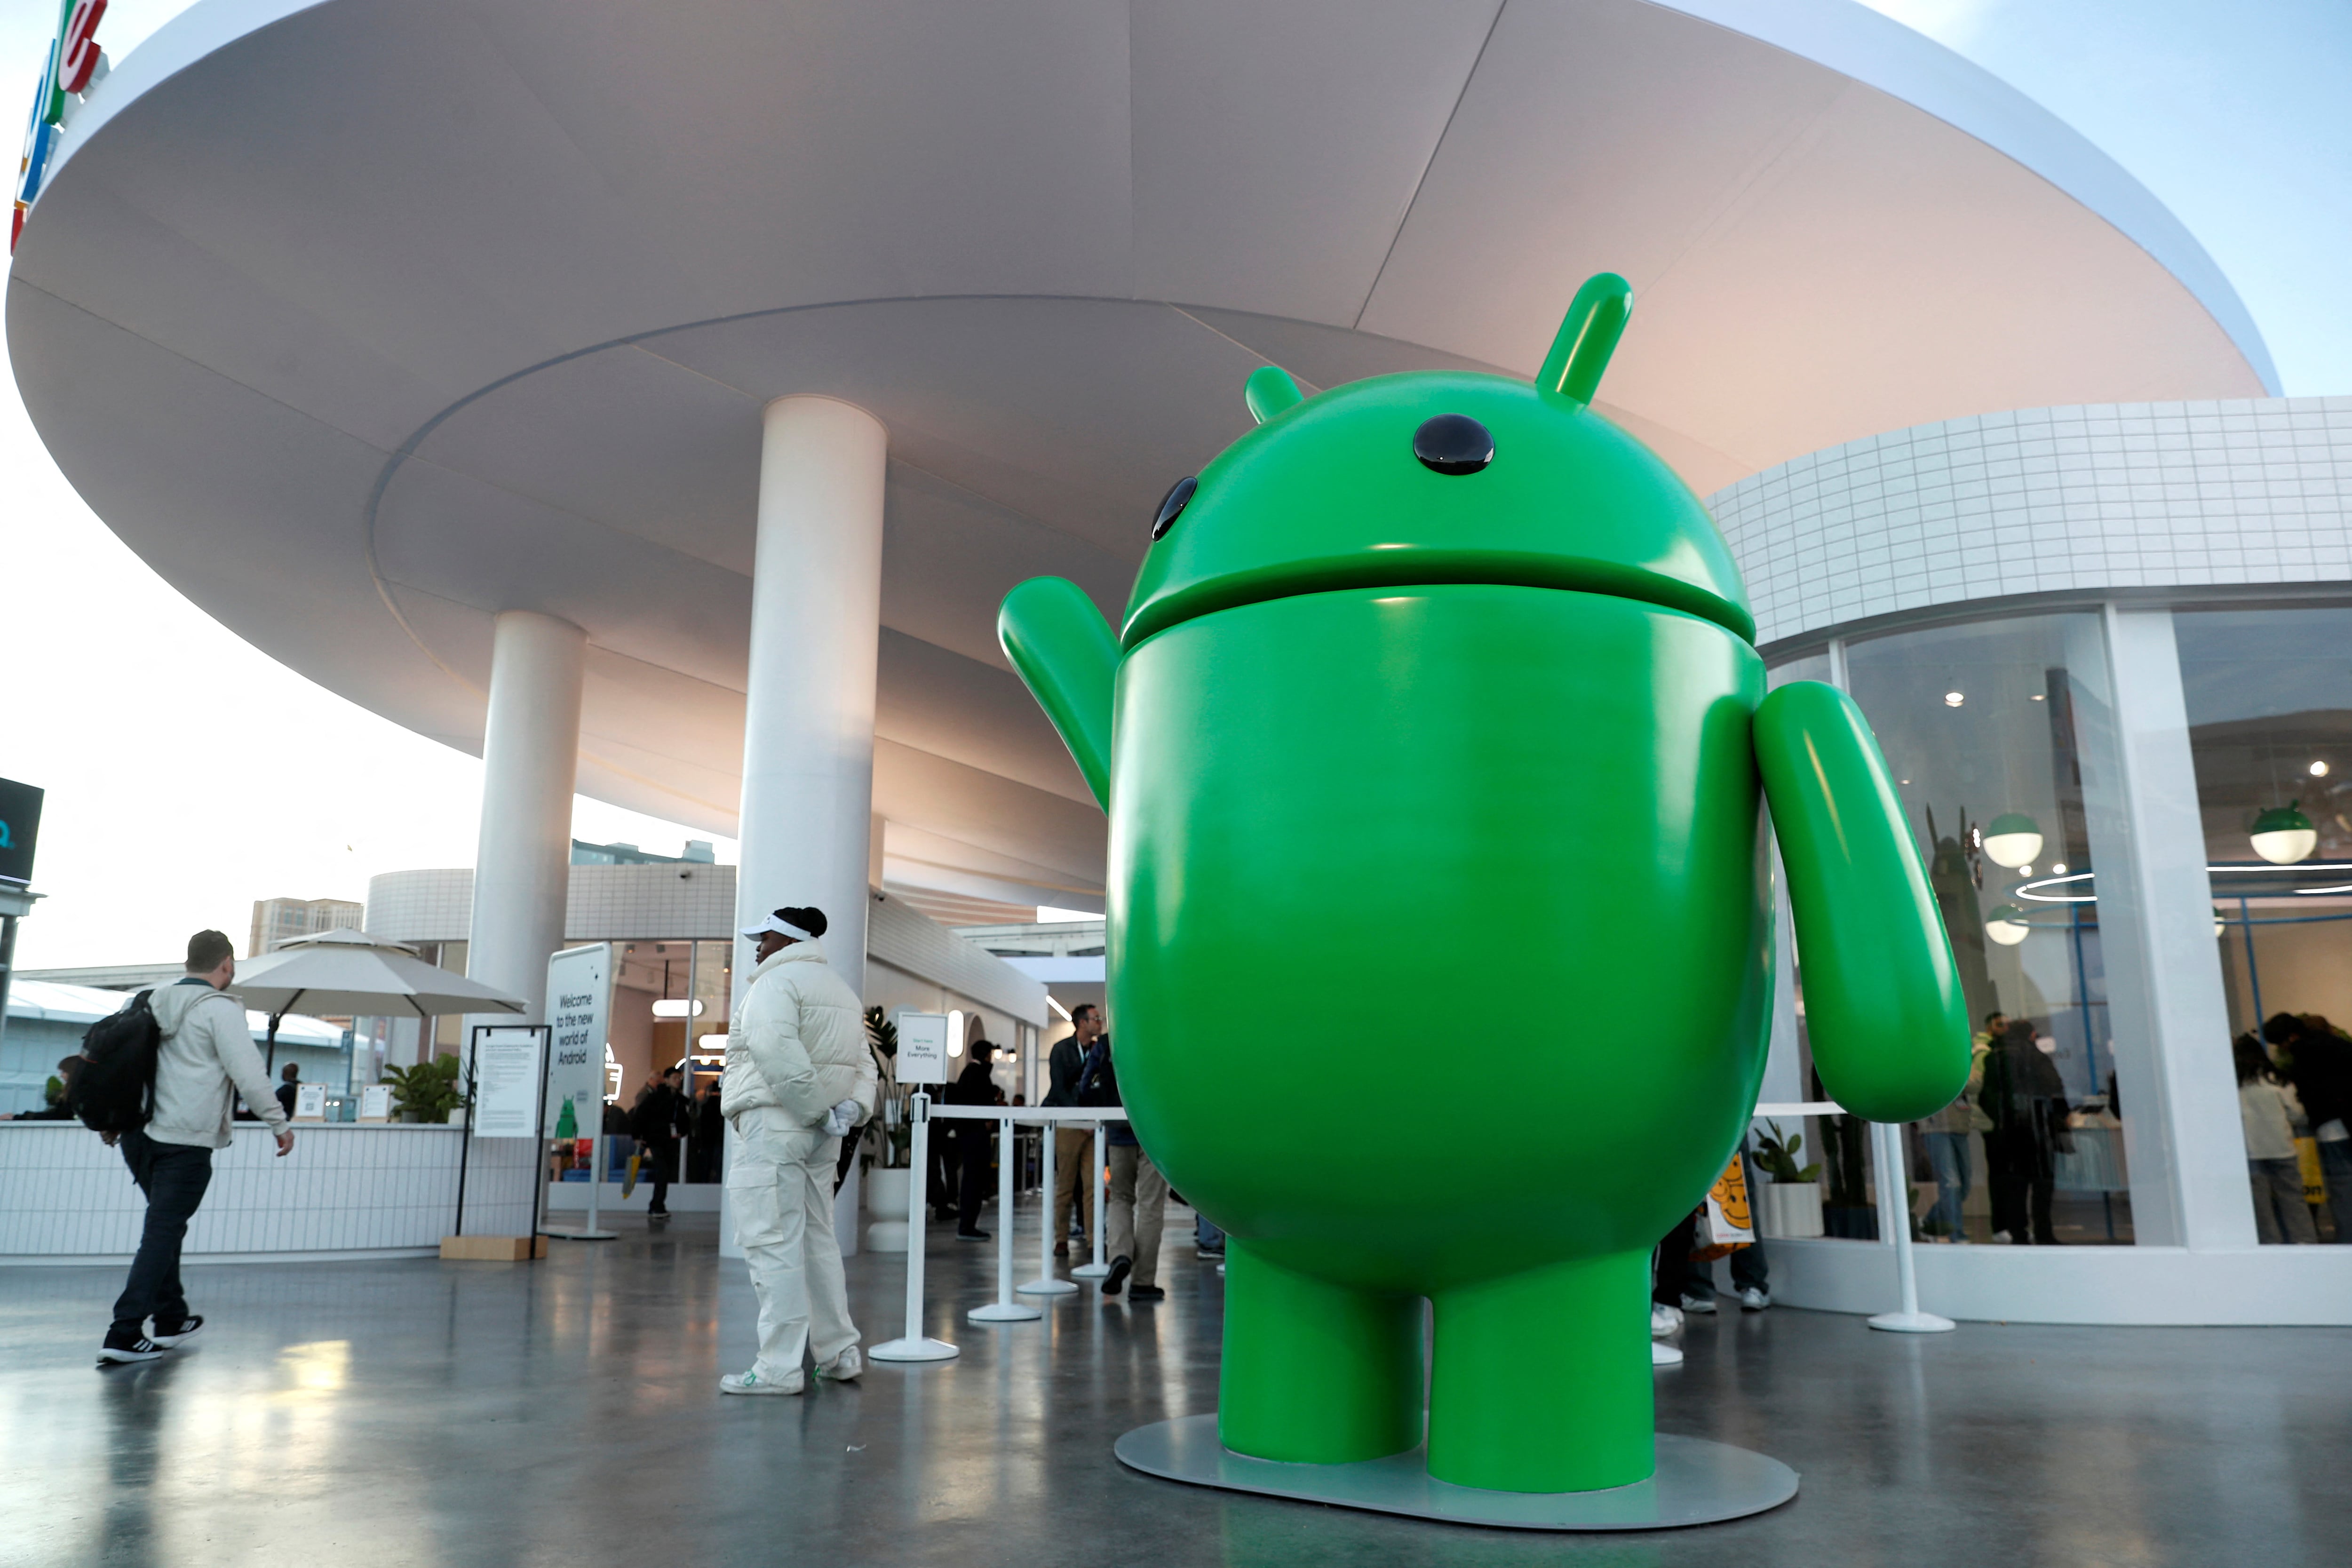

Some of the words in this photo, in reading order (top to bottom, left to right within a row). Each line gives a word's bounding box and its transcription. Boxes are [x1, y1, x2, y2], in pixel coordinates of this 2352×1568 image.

[560, 994, 592, 1009] Welcome
[556, 1016, 564, 1028] to
[565, 1013, 576, 1027] the
[578, 1013, 594, 1026] new
[559, 1030, 579, 1047] world
[580, 1029, 588, 1044] of
[557, 1049, 587, 1066] Android
